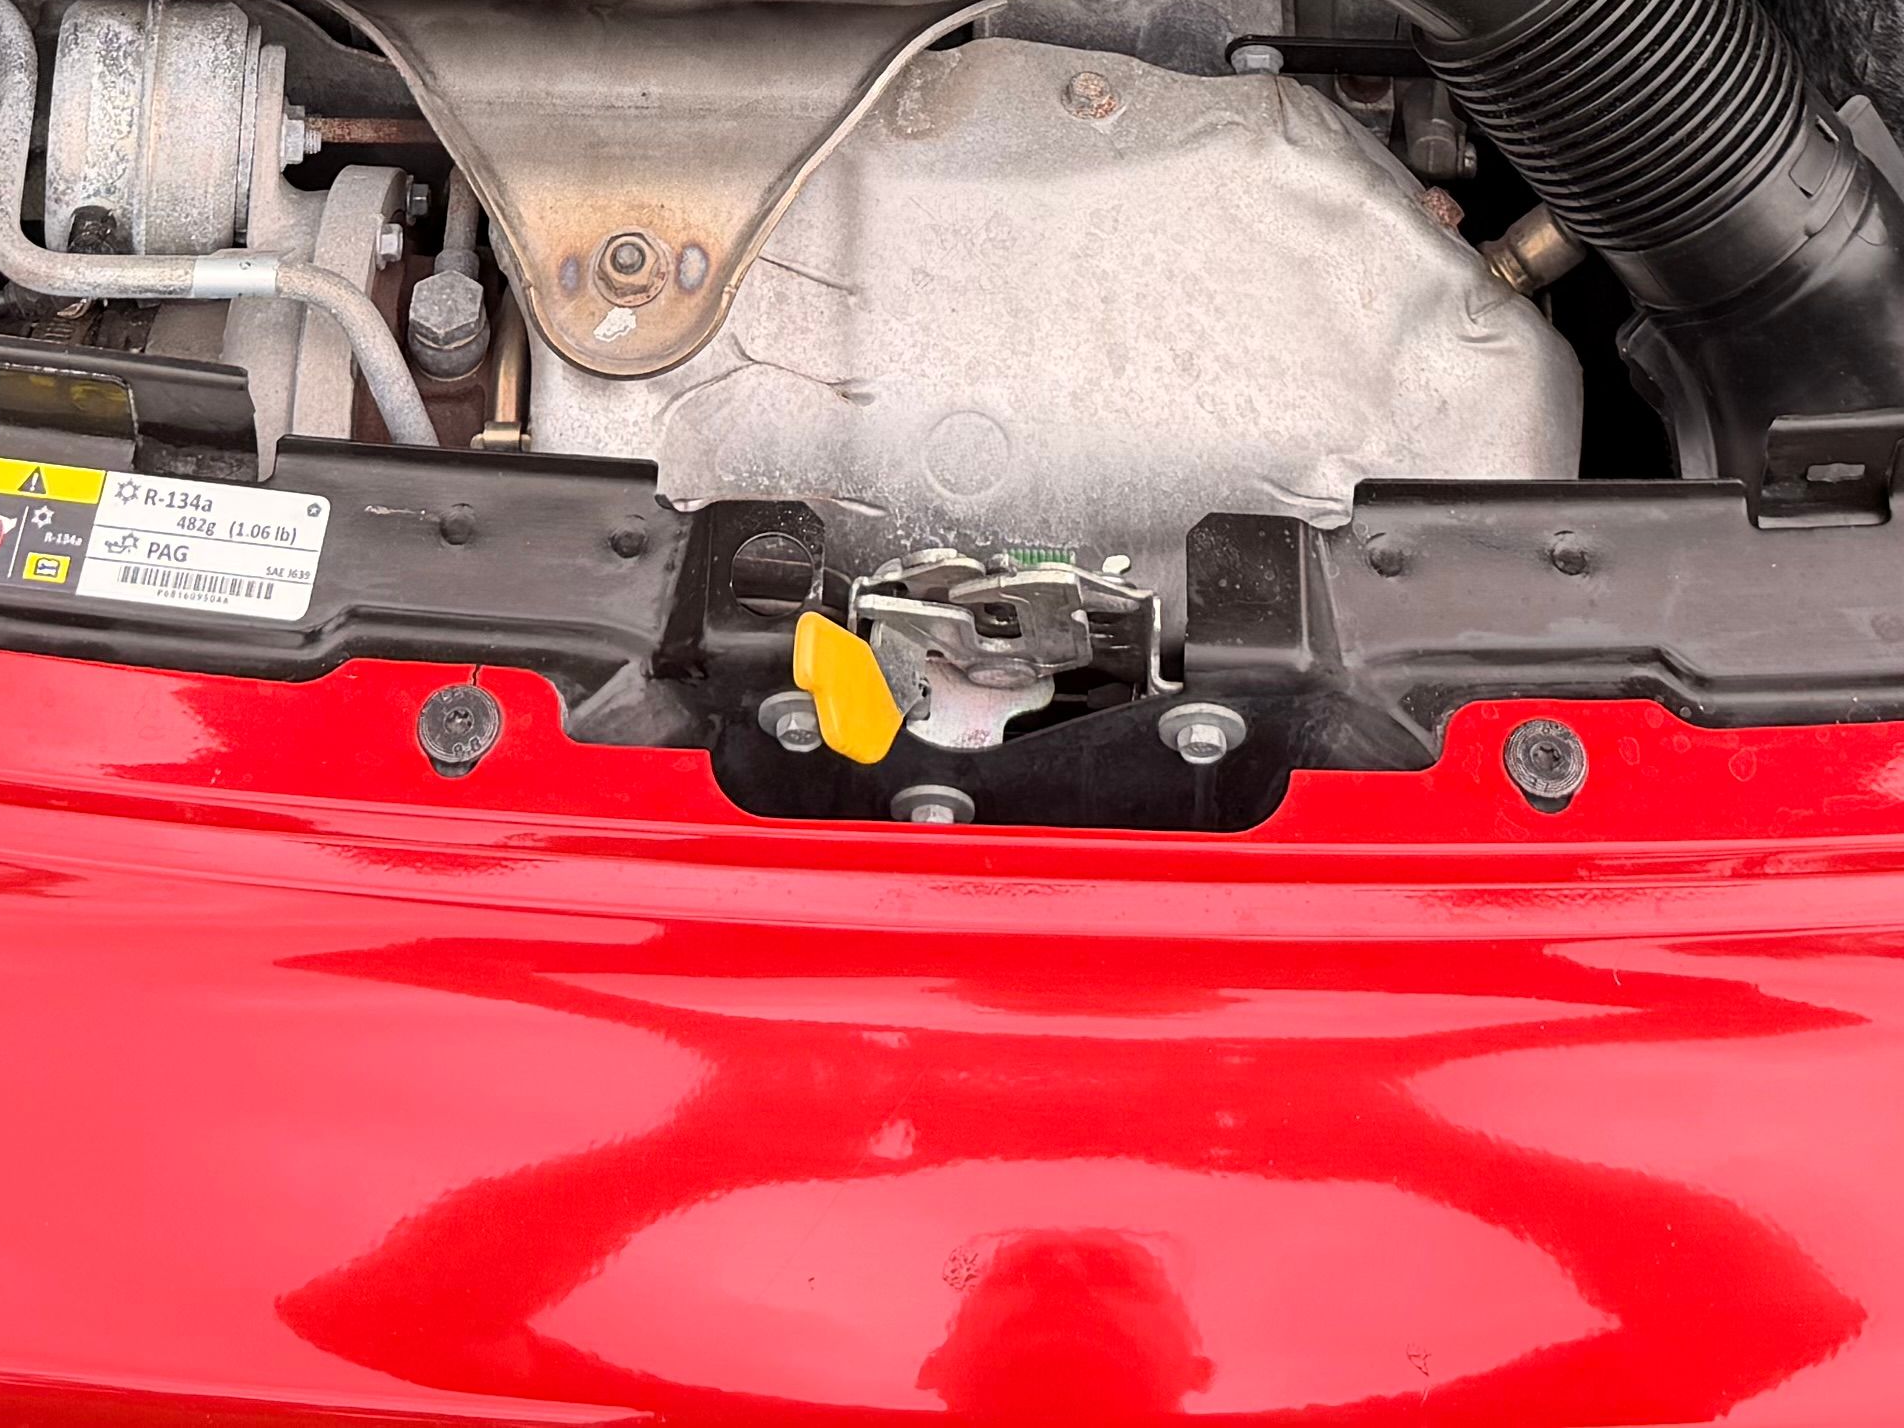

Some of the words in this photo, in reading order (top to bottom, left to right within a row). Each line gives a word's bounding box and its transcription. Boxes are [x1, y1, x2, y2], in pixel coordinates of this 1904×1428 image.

[144, 487, 214, 513] R-134a
[43, 530, 84, 547] R-134a
[176, 515, 217, 537] 482g
[229, 520, 272, 540] (1.06
[273, 524, 298, 546] lb)
[146, 541, 191, 564] PAG
[265, 565, 285, 577] SAE
